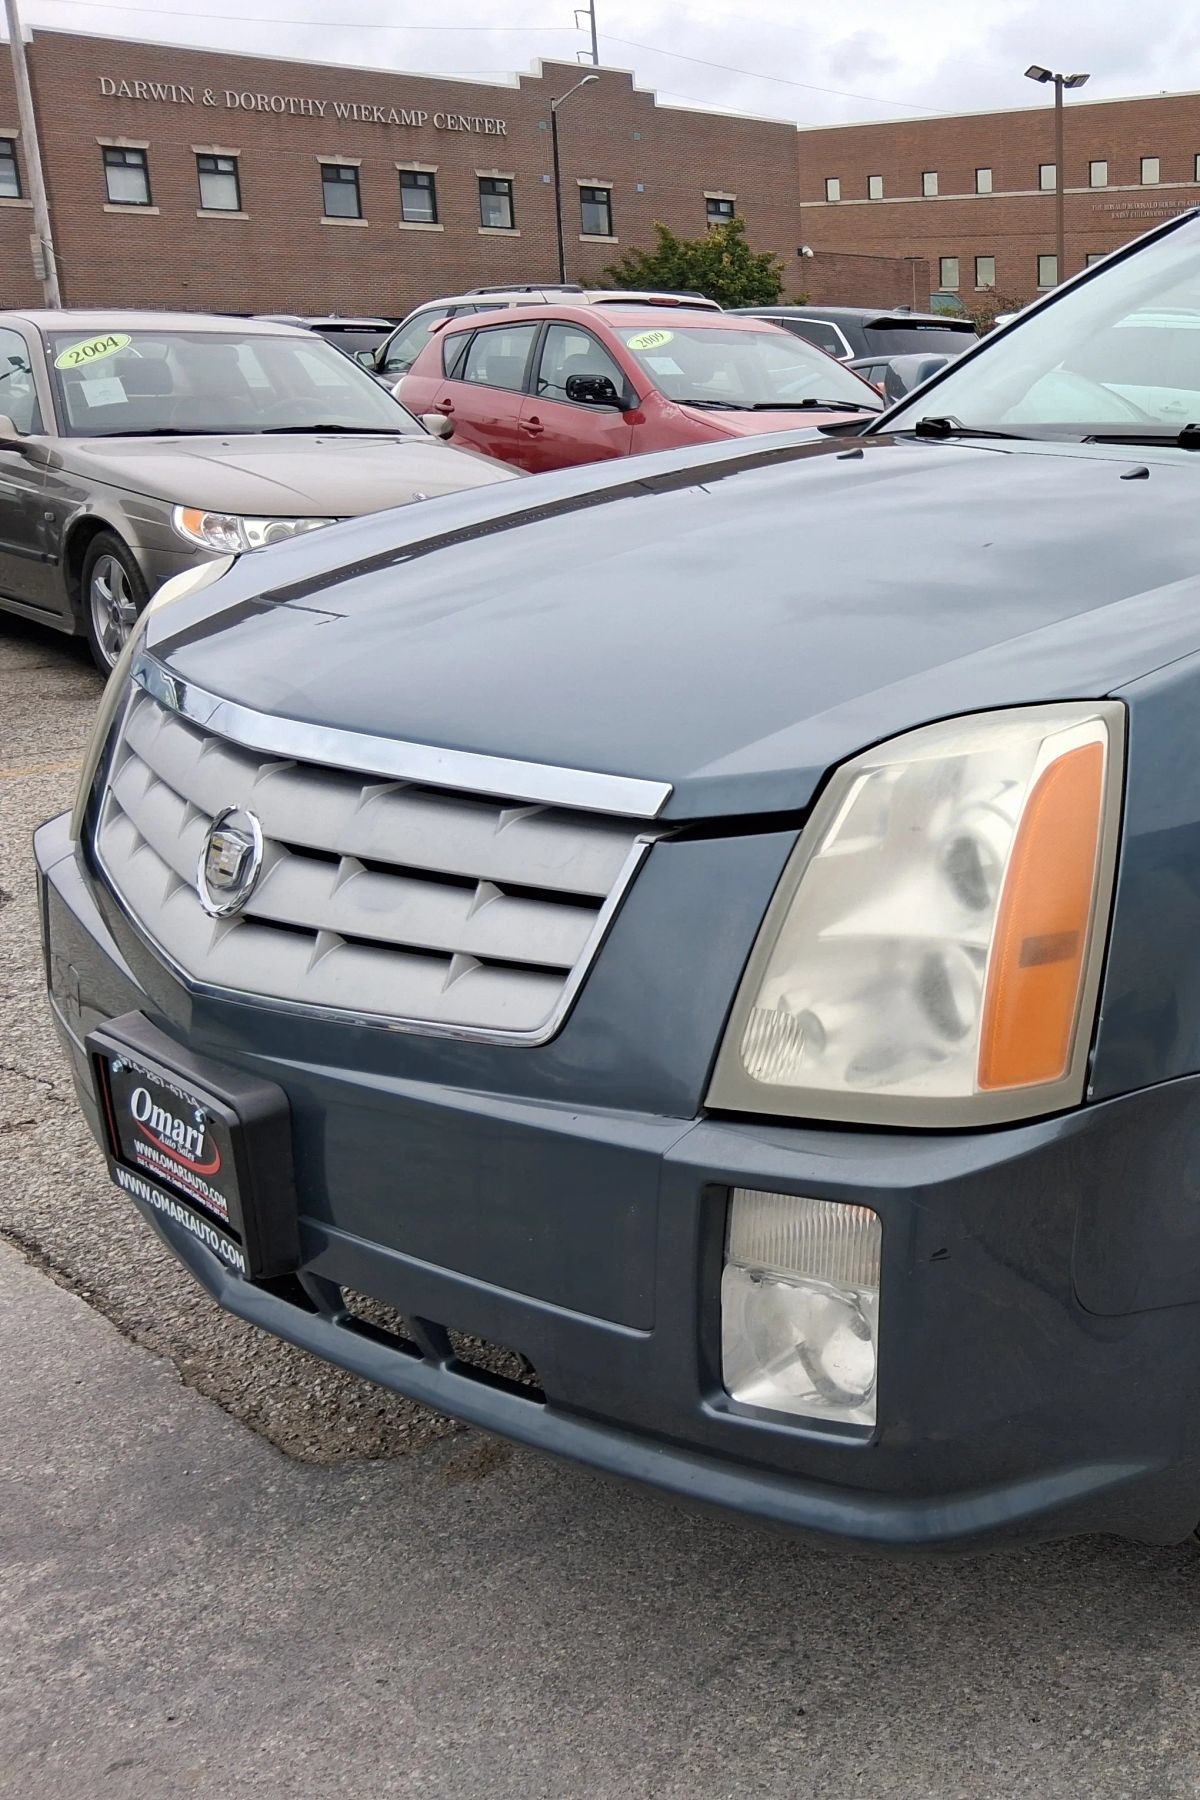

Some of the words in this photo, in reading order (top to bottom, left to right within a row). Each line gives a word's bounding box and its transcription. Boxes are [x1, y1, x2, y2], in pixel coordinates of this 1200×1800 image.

[99, 76, 195, 105] DARWIN
[202, 88, 217, 107] &
[223, 90, 326, 118] DOROTHY
[333, 102, 428, 127] WIEKAMP
[433, 113, 508, 136] CENTER
[68, 336, 119, 364] 2004
[636, 332, 664, 348] 2009
[131, 1087, 205, 1158] Omari
[159, 1133, 177, 1150] Auto
[133, 1139, 228, 1212] WWW.OMARIAUTO.COM
[116, 1167, 246, 1273] WWW.OMARIAUTO.COM
